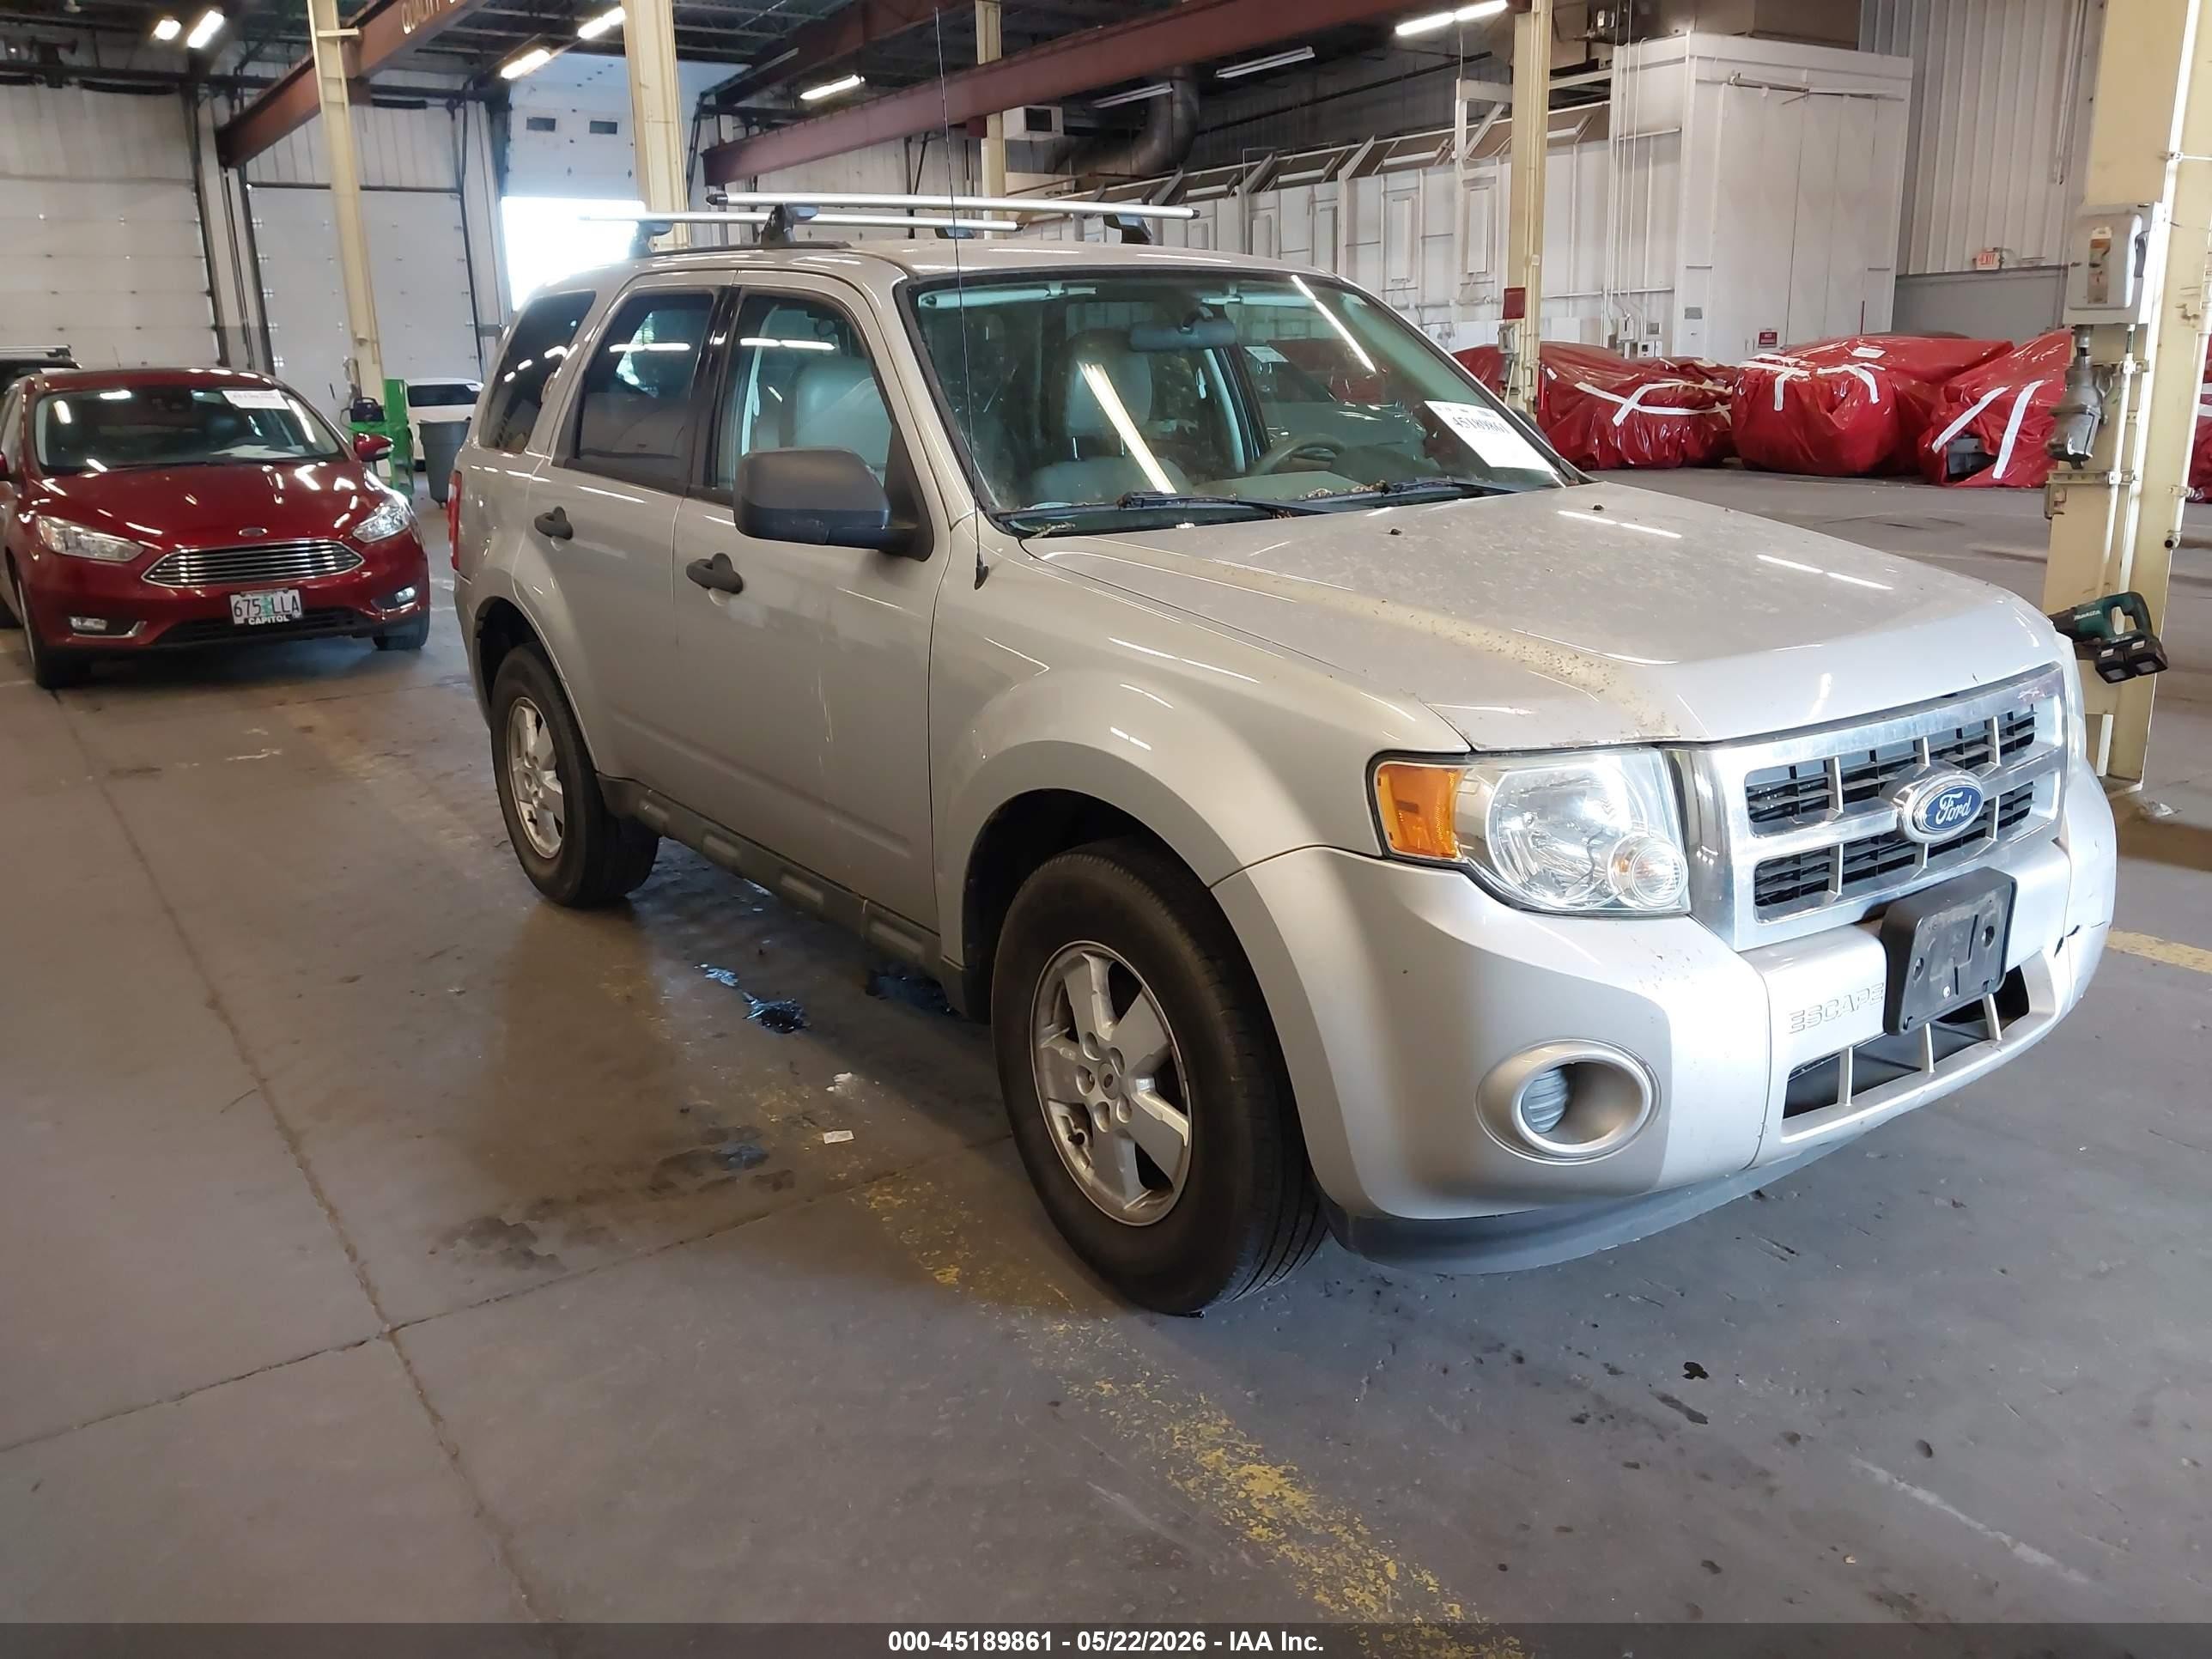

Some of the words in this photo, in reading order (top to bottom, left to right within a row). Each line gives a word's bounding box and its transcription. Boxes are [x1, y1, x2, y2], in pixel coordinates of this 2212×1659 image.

[234, 598, 262, 617] 675
[270, 595, 300, 614] LLA
[247, 615, 289, 625] CAPITOL
[1935, 791, 1972, 825] Ford
[1788, 981, 1885, 1035] ESCAPE
